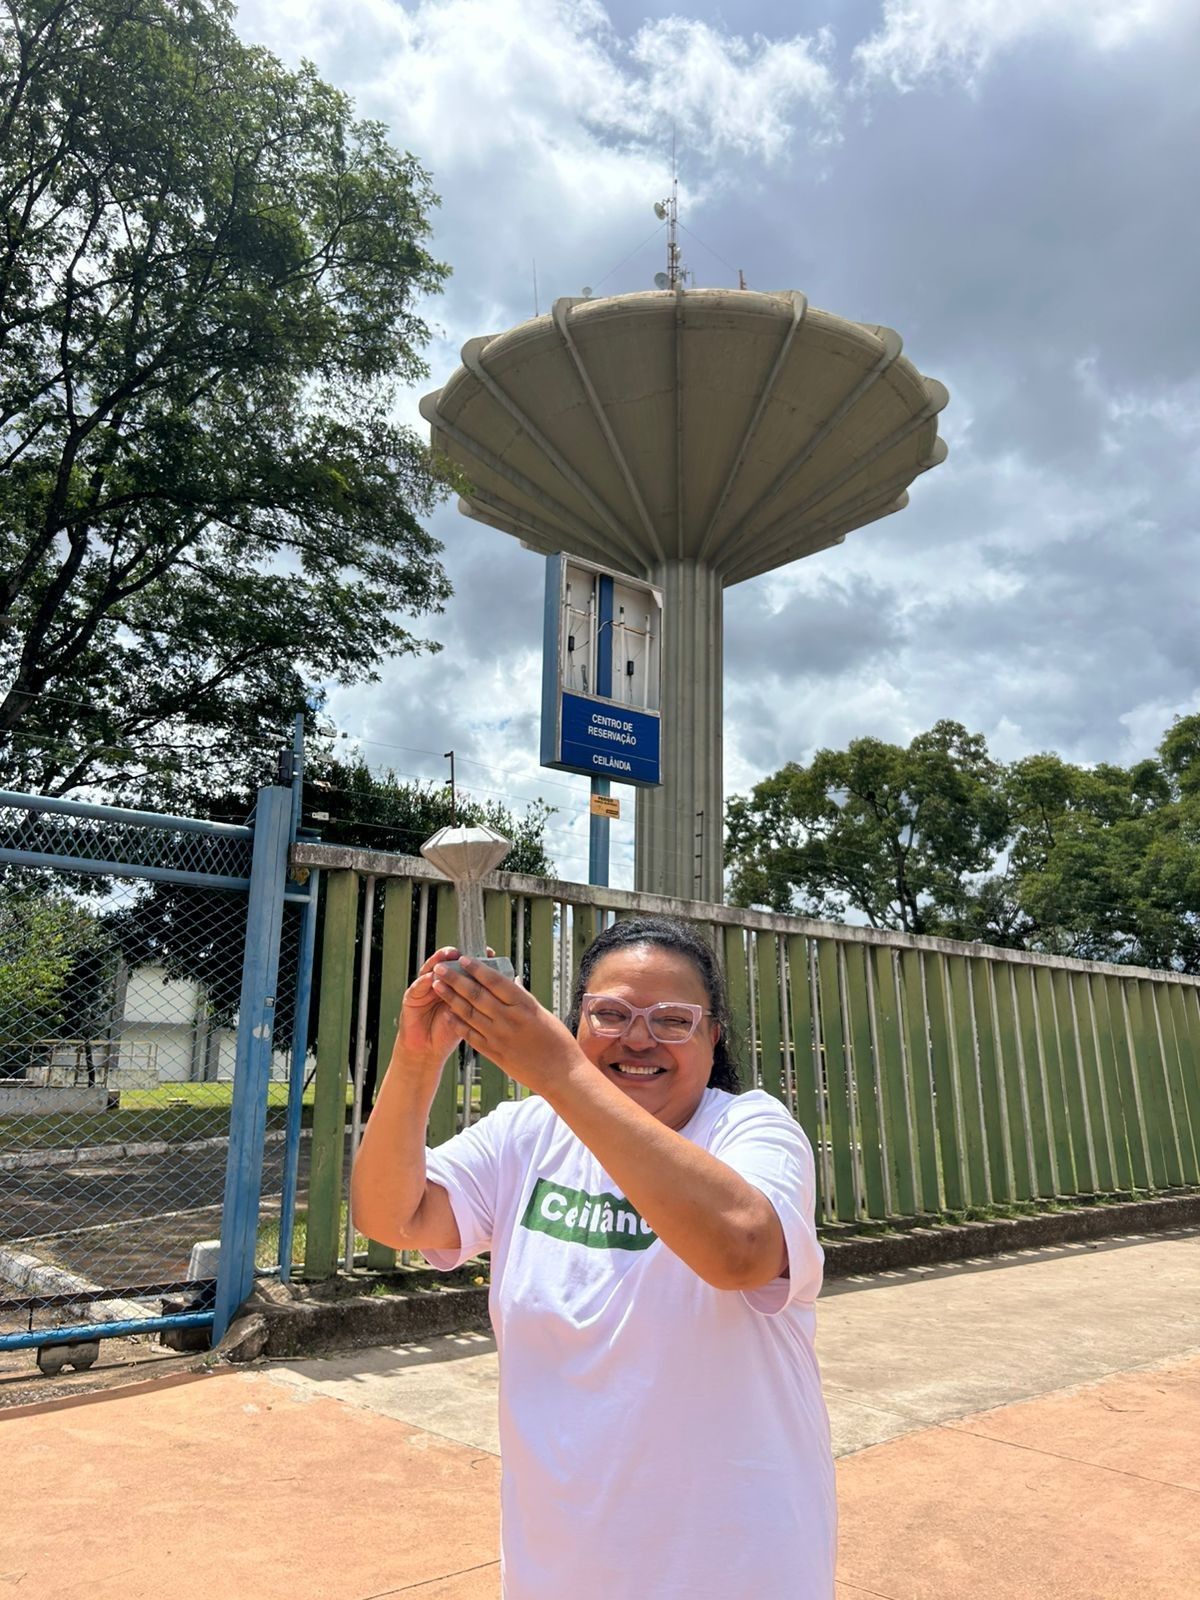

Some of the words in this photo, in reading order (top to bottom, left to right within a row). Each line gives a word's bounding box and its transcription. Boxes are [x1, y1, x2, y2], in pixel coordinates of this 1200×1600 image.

[591, 713, 622, 730] CENTRO
[622, 722, 633, 732] DE
[588, 726, 637, 746] RESERVAÇÃO
[592, 754, 632, 771] CEILÂNDIA
